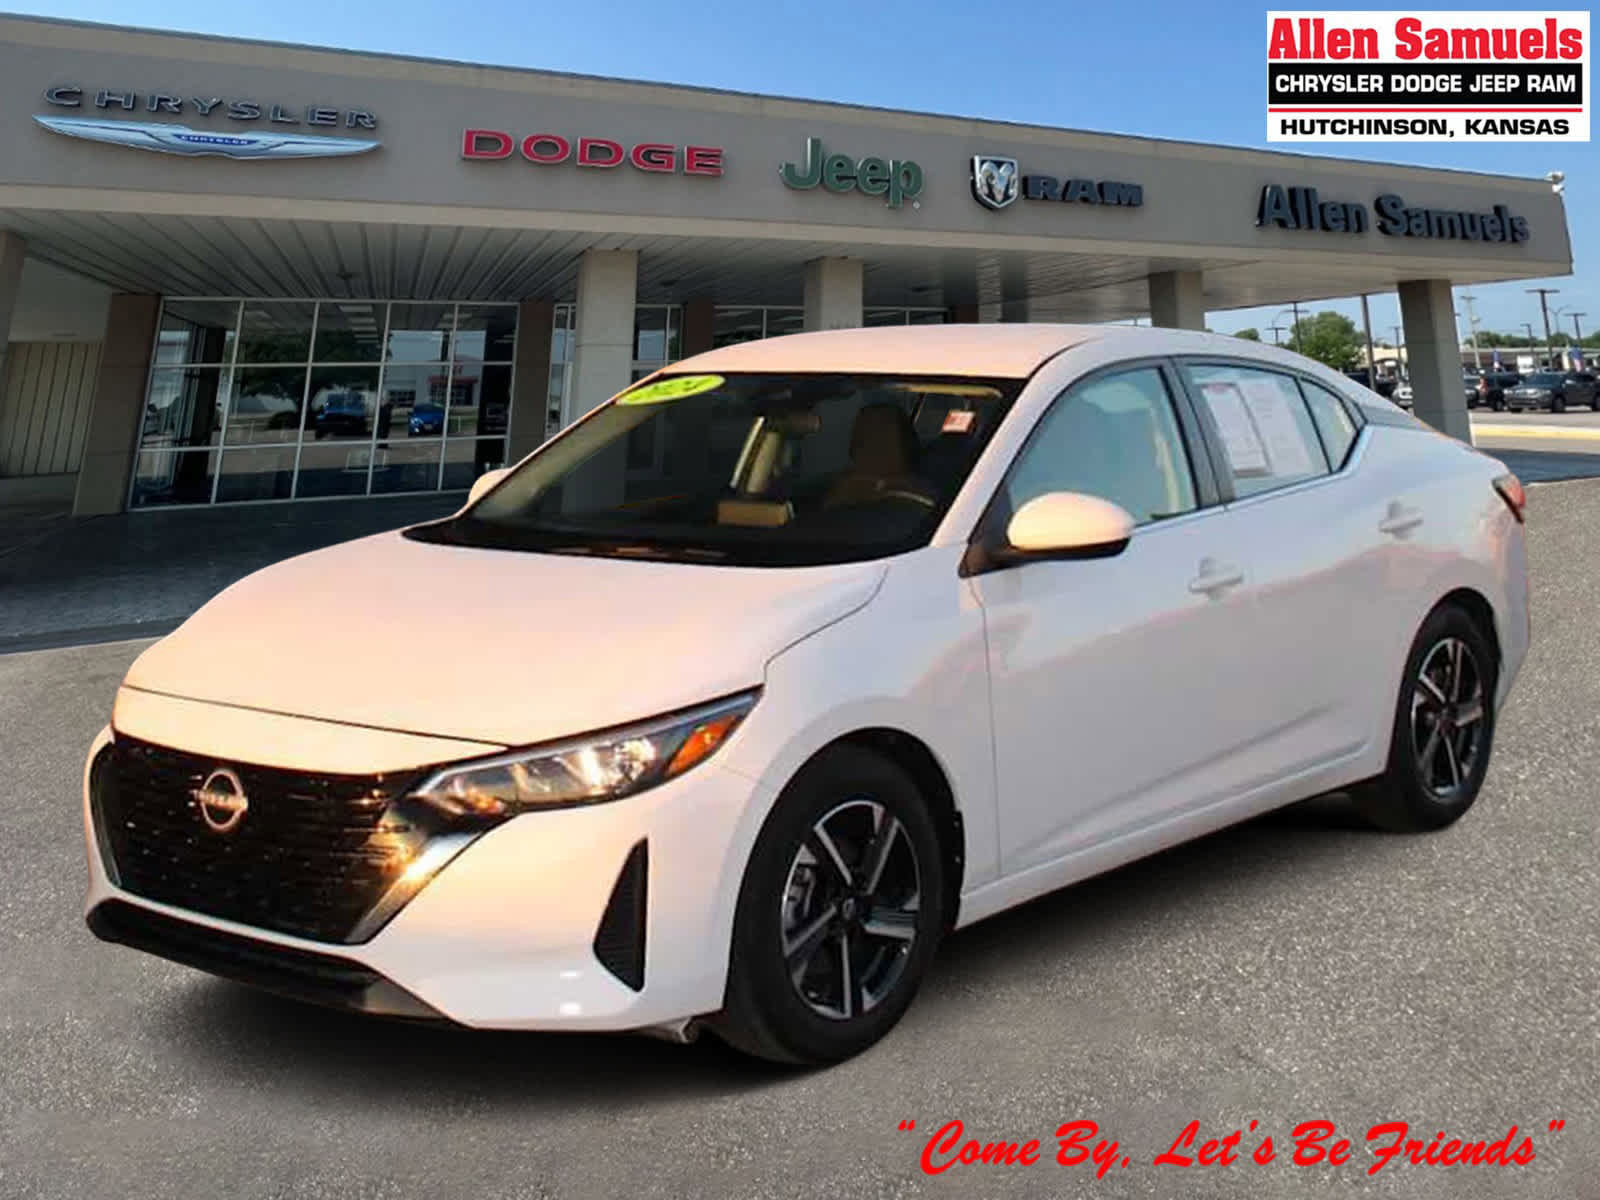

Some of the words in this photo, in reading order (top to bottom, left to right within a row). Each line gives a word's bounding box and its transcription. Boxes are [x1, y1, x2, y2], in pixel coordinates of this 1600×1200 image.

[43, 86, 377, 130] CHRYSLER
[462, 128, 725, 177] DODGE
[780, 137, 924, 209] Jeep
[1023, 174, 1144, 207] RAM
[1256, 184, 1369, 233] Allen
[1375, 193, 1531, 243] Samuels
